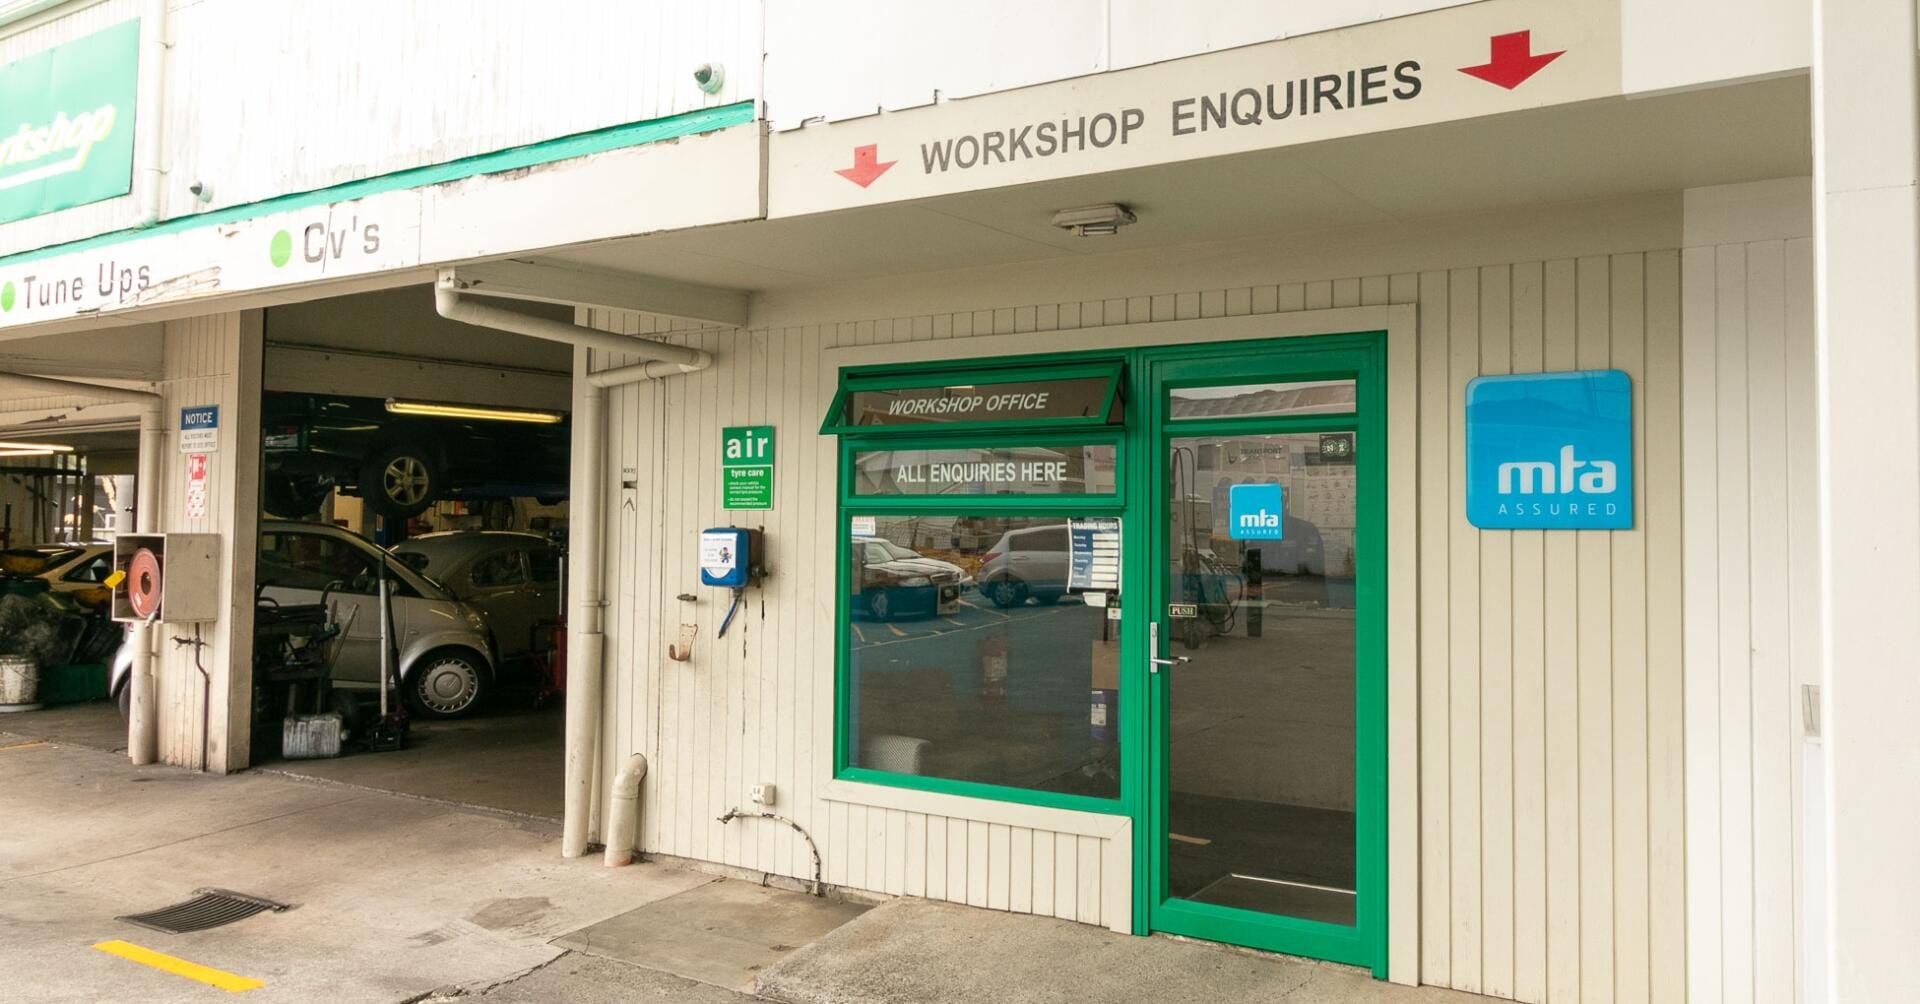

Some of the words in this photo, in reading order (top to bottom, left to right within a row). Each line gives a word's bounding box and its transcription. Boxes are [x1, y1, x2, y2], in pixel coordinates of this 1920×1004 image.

[920, 108, 1144, 174] WORKSHOP
[1171, 60, 1423, 137] ENQUIRIES
[24, 275, 84, 310] Tune
[98, 261, 151, 304] Ups
[889, 396, 983, 416] WORKSHOP
[986, 392, 1049, 411] OFFICE
[185, 412, 213, 425] NOTICE
[726, 430, 769, 459] air
[731, 469, 746, 479] tyre
[747, 469, 764, 477] care
[897, 464, 926, 483] ALL
[930, 462, 1016, 483] ENQUIRIES
[1021, 461, 1068, 482] HERE
[1498, 444, 1617, 494] mta
[1240, 508, 1279, 527] mta
[1498, 503, 1617, 516] ASSURED
[1172, 606, 1194, 615] PUSH
